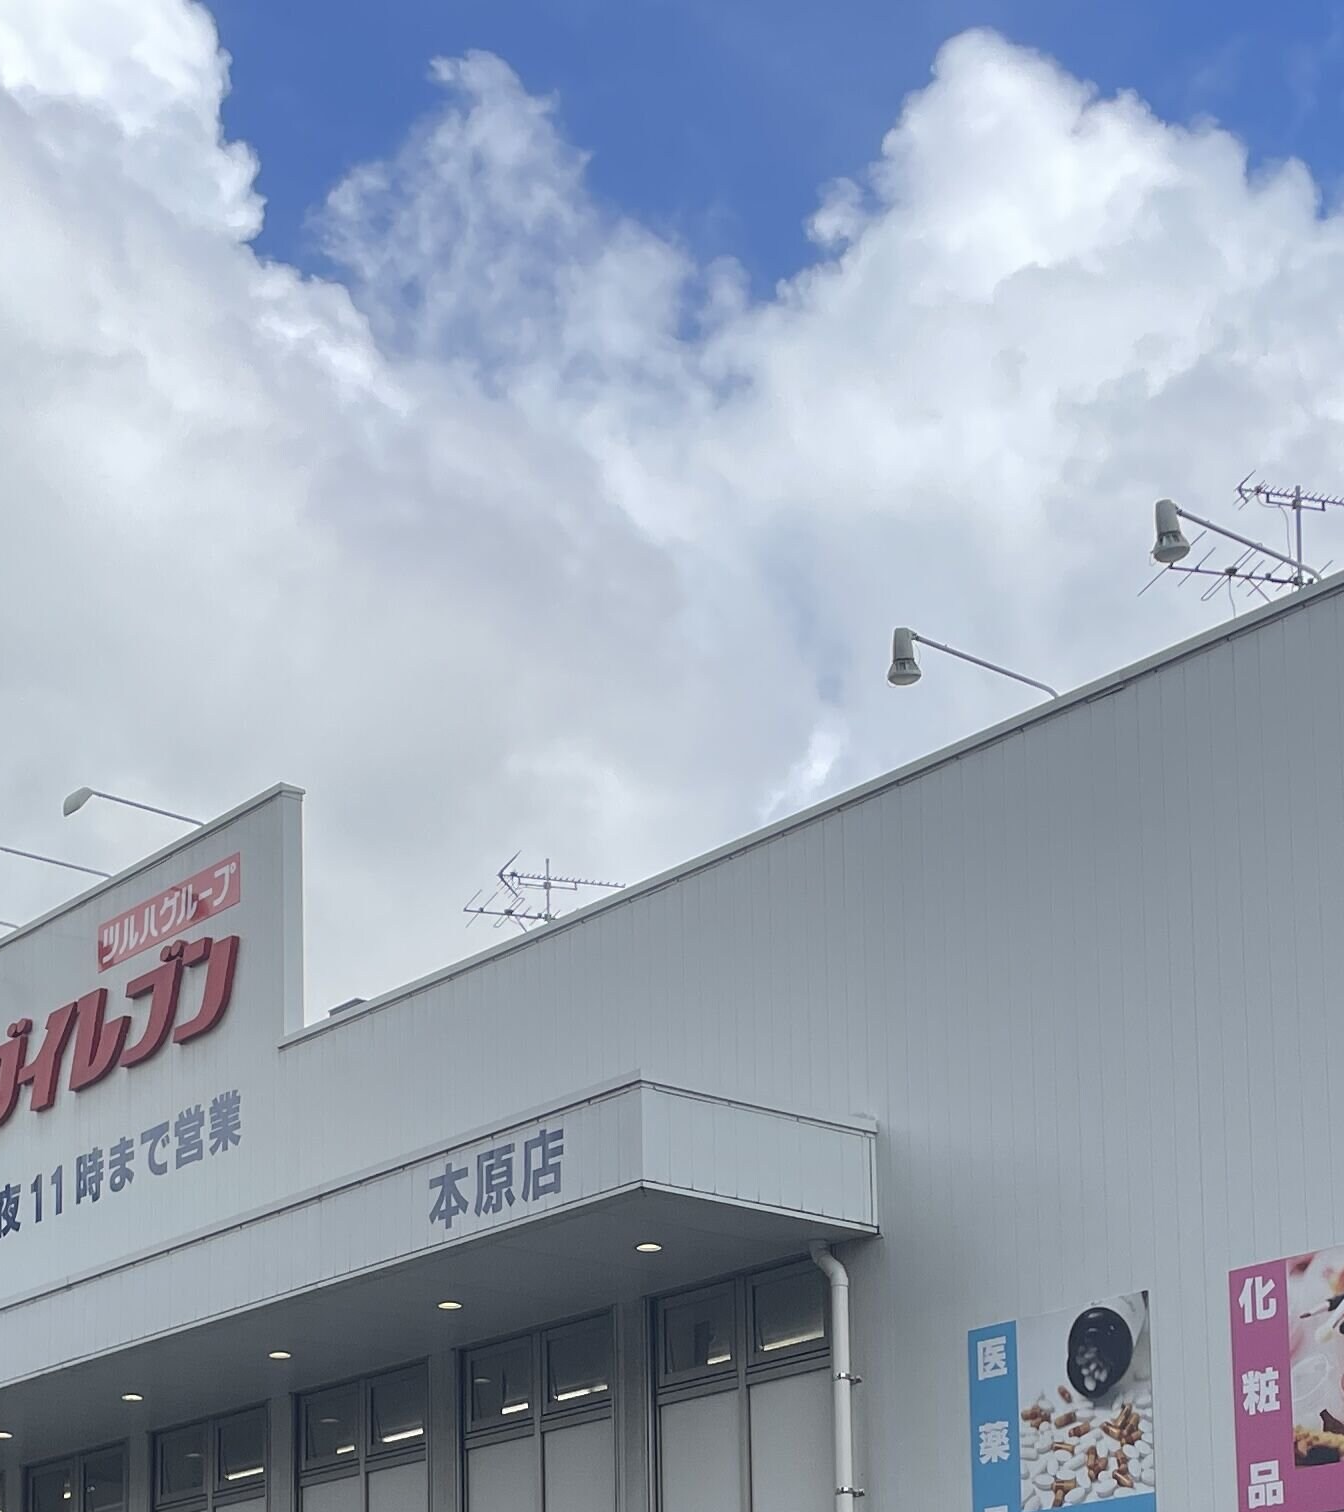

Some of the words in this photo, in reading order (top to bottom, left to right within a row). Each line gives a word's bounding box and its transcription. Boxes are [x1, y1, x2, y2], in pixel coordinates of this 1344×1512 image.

[102, 861, 237, 964] ツルハグループ
[428, 1127, 565, 1230] 本原店
[1238, 1276, 1285, 1510] 化粧品
